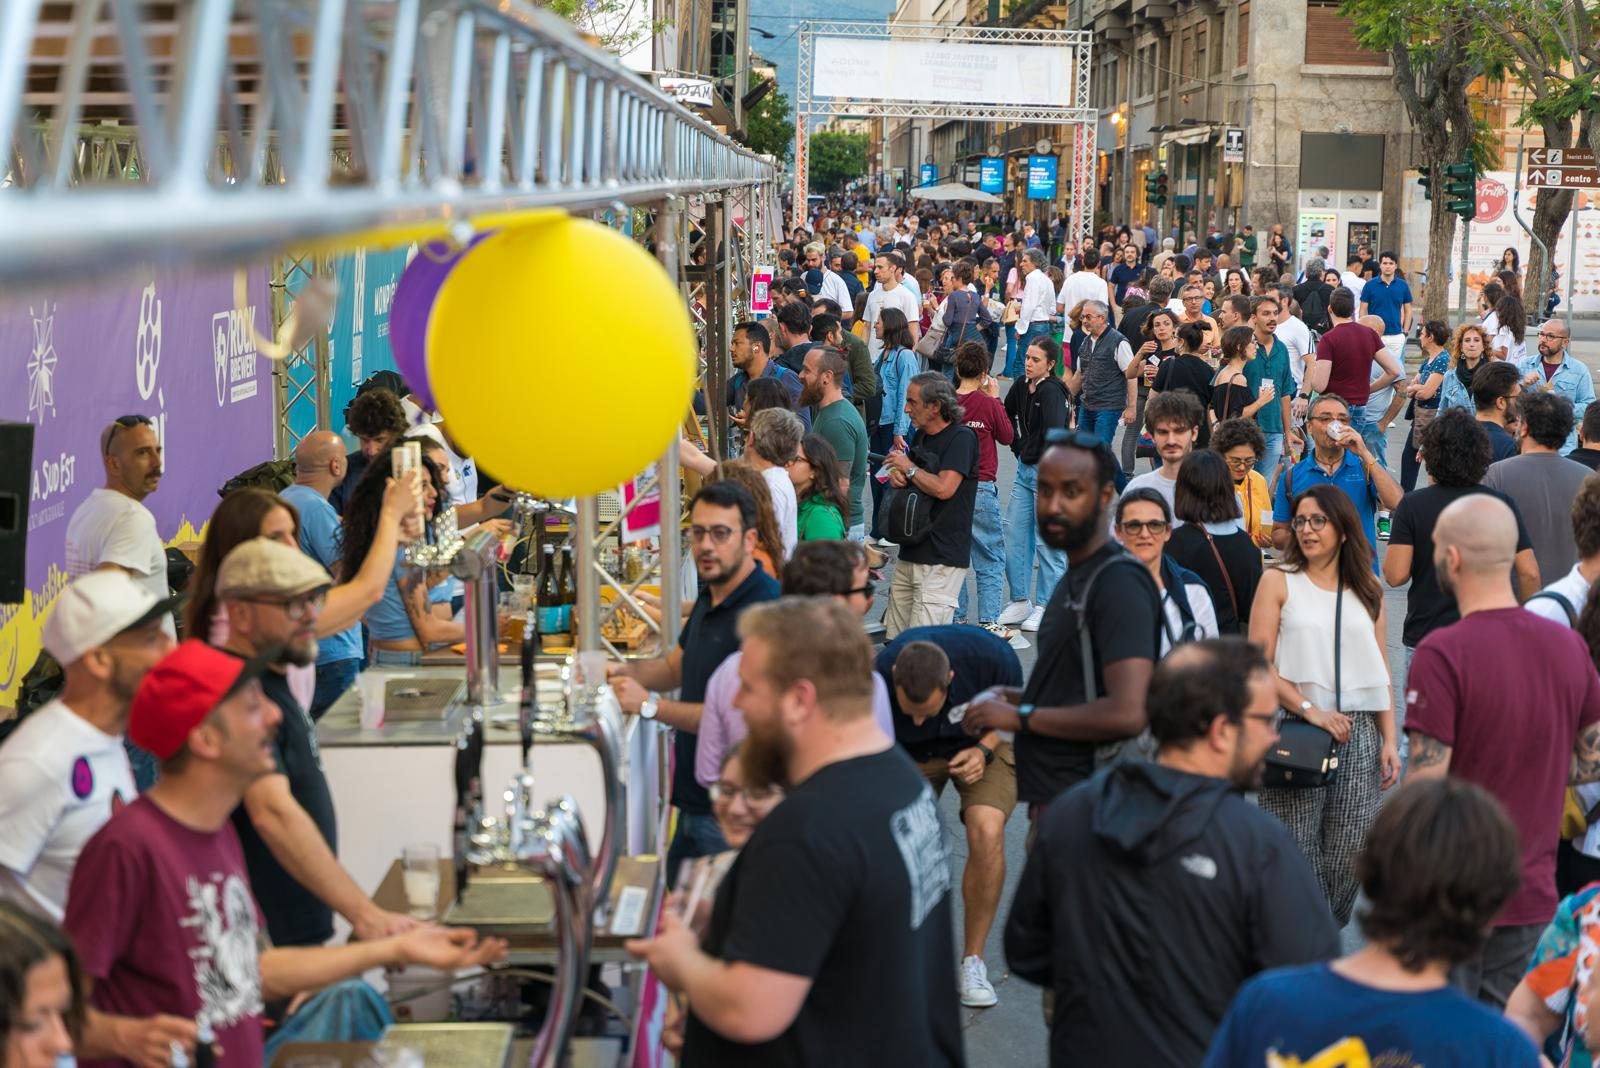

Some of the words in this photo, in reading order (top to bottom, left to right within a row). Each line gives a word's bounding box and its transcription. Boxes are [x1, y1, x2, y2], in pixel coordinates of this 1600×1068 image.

[1228, 131, 1242, 148] T
[1565, 174, 1592, 183] centro
[230, 305, 257, 358] ROCK
[230, 352, 257, 383] BREWERY
